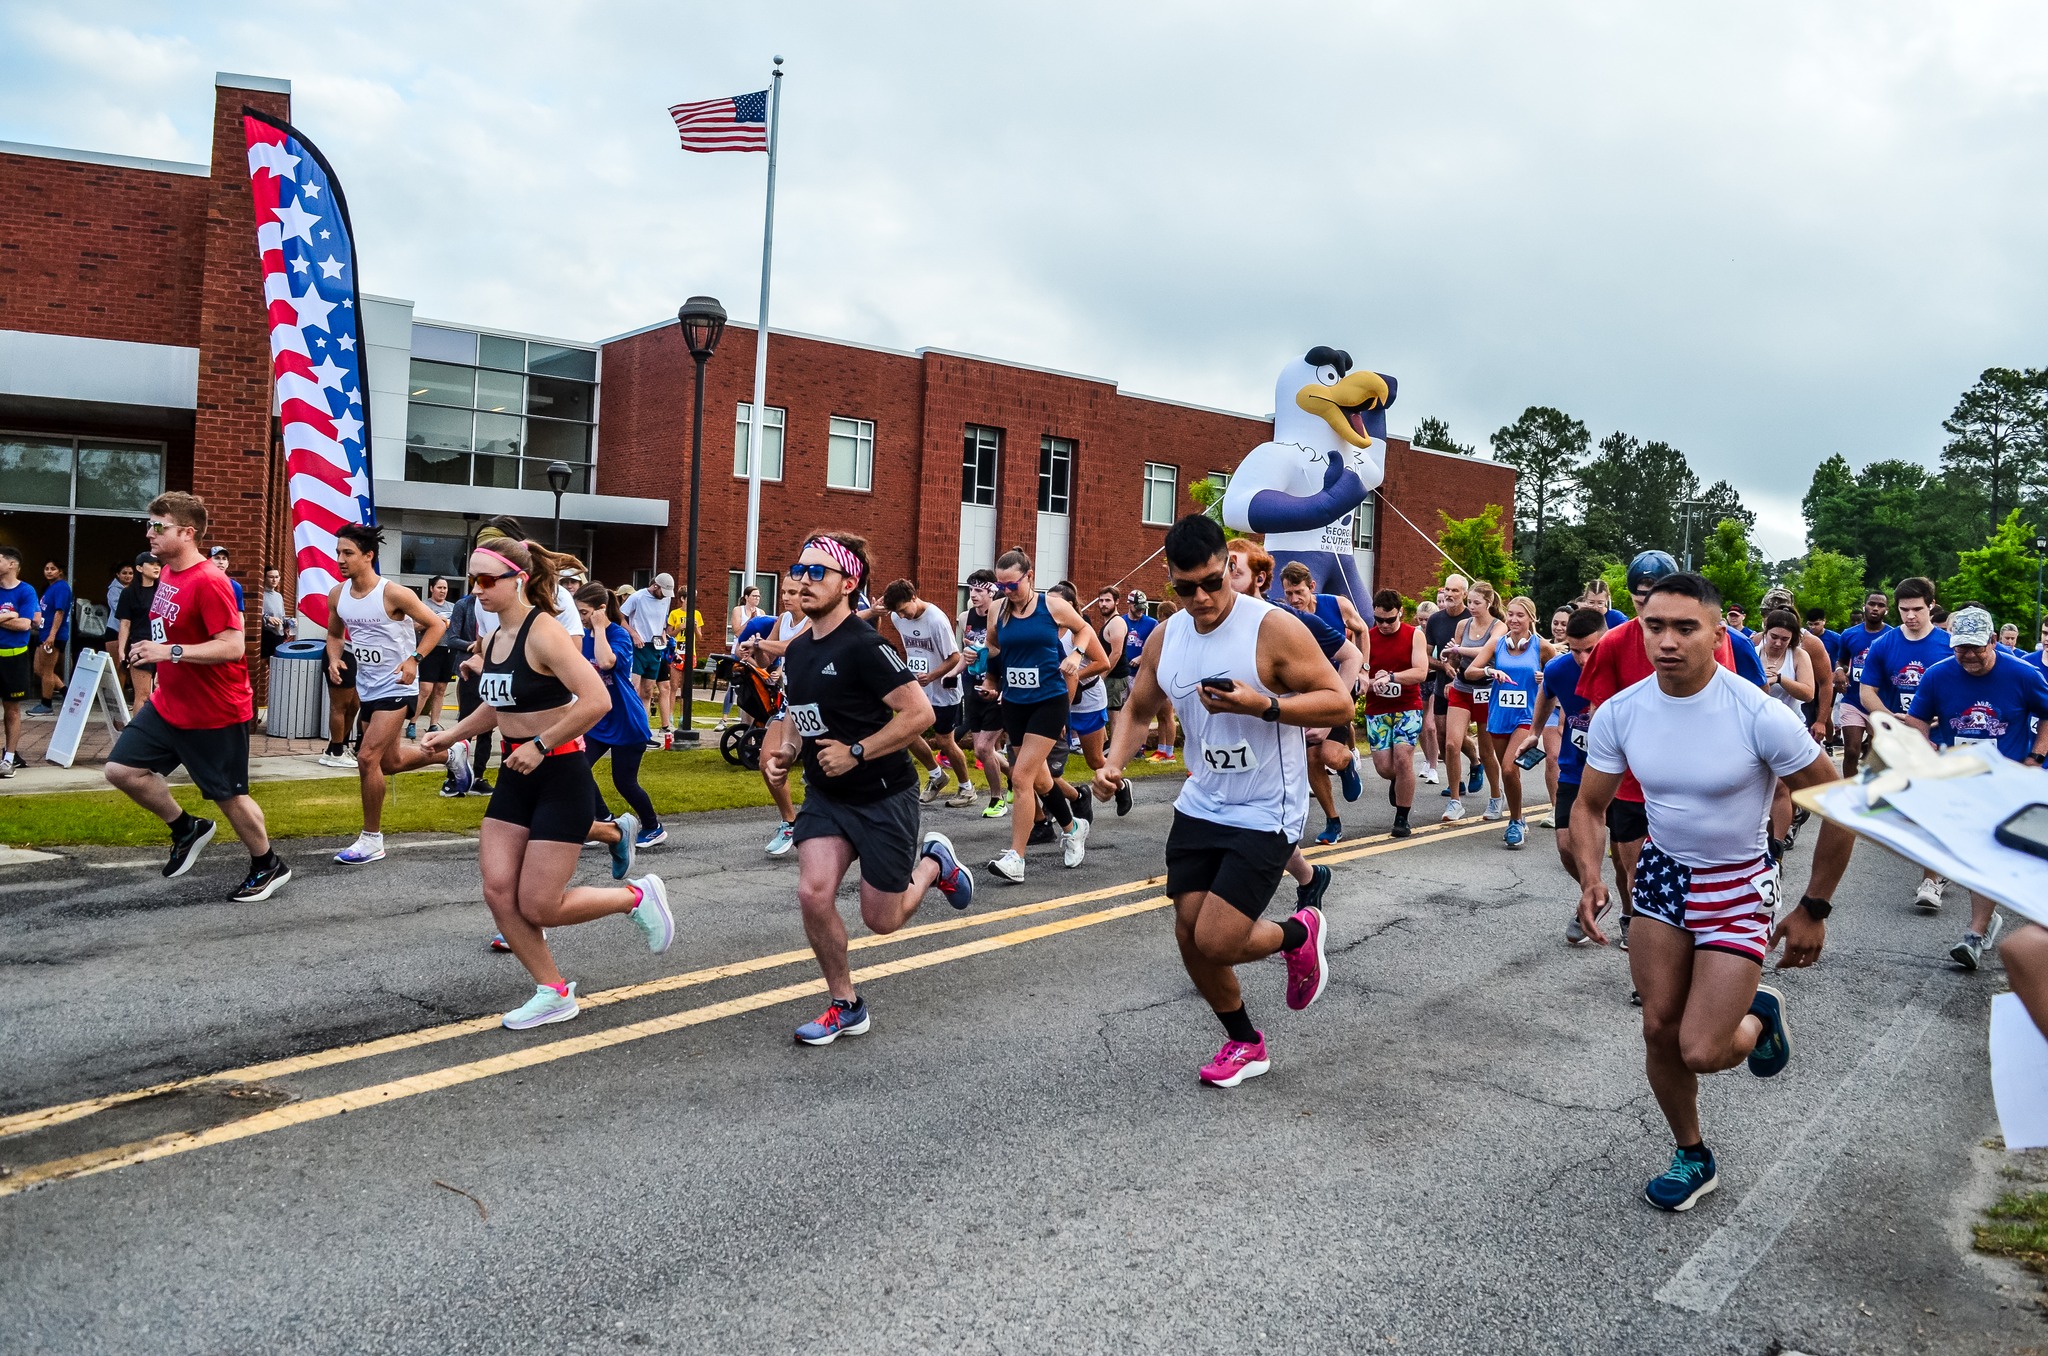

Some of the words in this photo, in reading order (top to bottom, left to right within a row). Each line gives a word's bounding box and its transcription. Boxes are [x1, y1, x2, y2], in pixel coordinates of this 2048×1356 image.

[354, 647, 381, 664] 430
[907, 659, 927, 671] 483
[1008, 671, 1037, 686] 383
[480, 679, 510, 702] 414
[1475, 691, 1490, 702] 43
[1500, 693, 1525, 706] 412
[791, 709, 821, 732] 388
[1573, 734, 1588, 749] 4
[1205, 746, 1248, 769] 427
